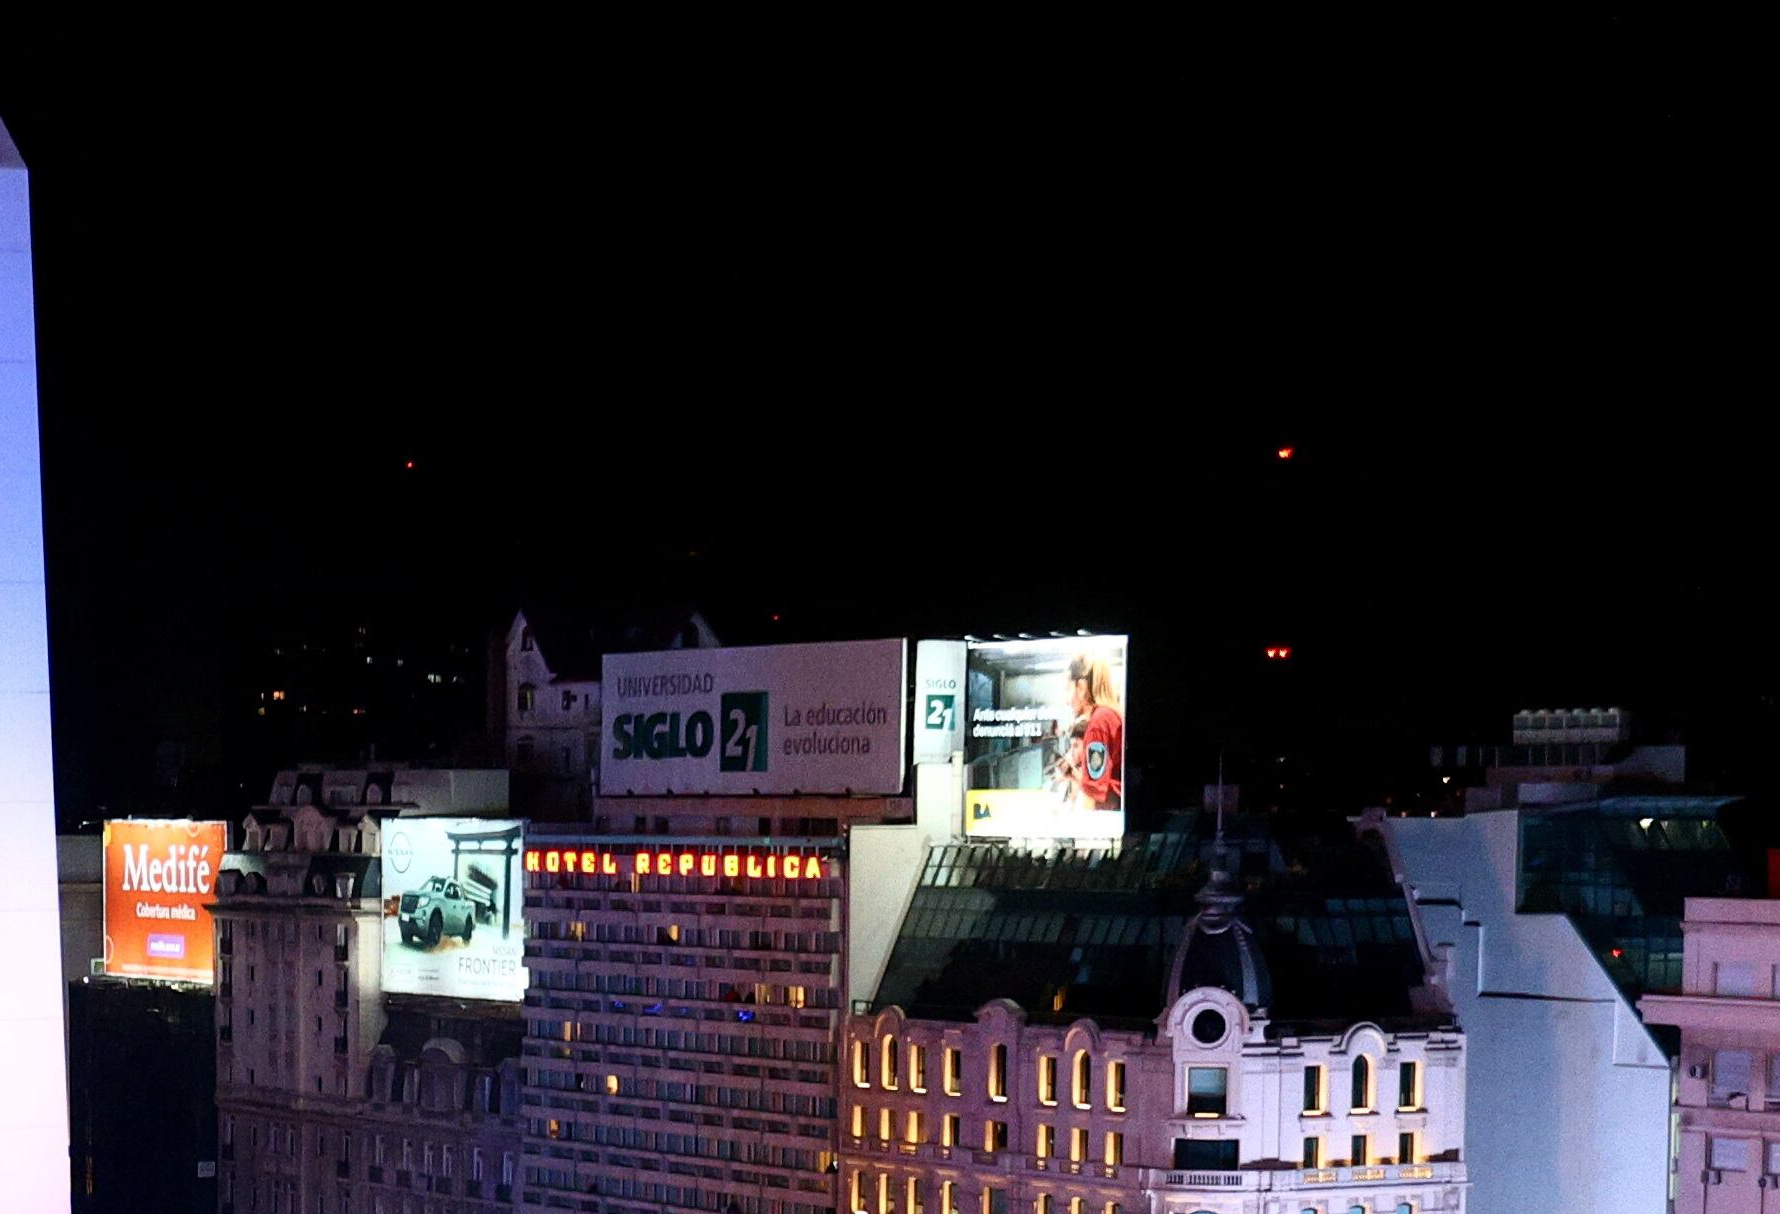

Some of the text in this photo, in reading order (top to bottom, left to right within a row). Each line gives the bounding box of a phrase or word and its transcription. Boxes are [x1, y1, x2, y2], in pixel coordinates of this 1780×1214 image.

[617, 673, 713, 697] UNIVERSIDAD
[925, 678, 957, 689] SIGLO
[784, 701, 887, 727] La educación
[927, 700, 953, 732] 21
[612, 708, 758, 772] SIGLO 21
[783, 732, 871, 756] evoluciona
[123, 844, 210, 894] Medifé
[526, 851, 821, 879] HOTEL REPUBLICA
[136, 902, 196, 920] Cobertura médica
[459, 957, 516, 976] FRONTIER
